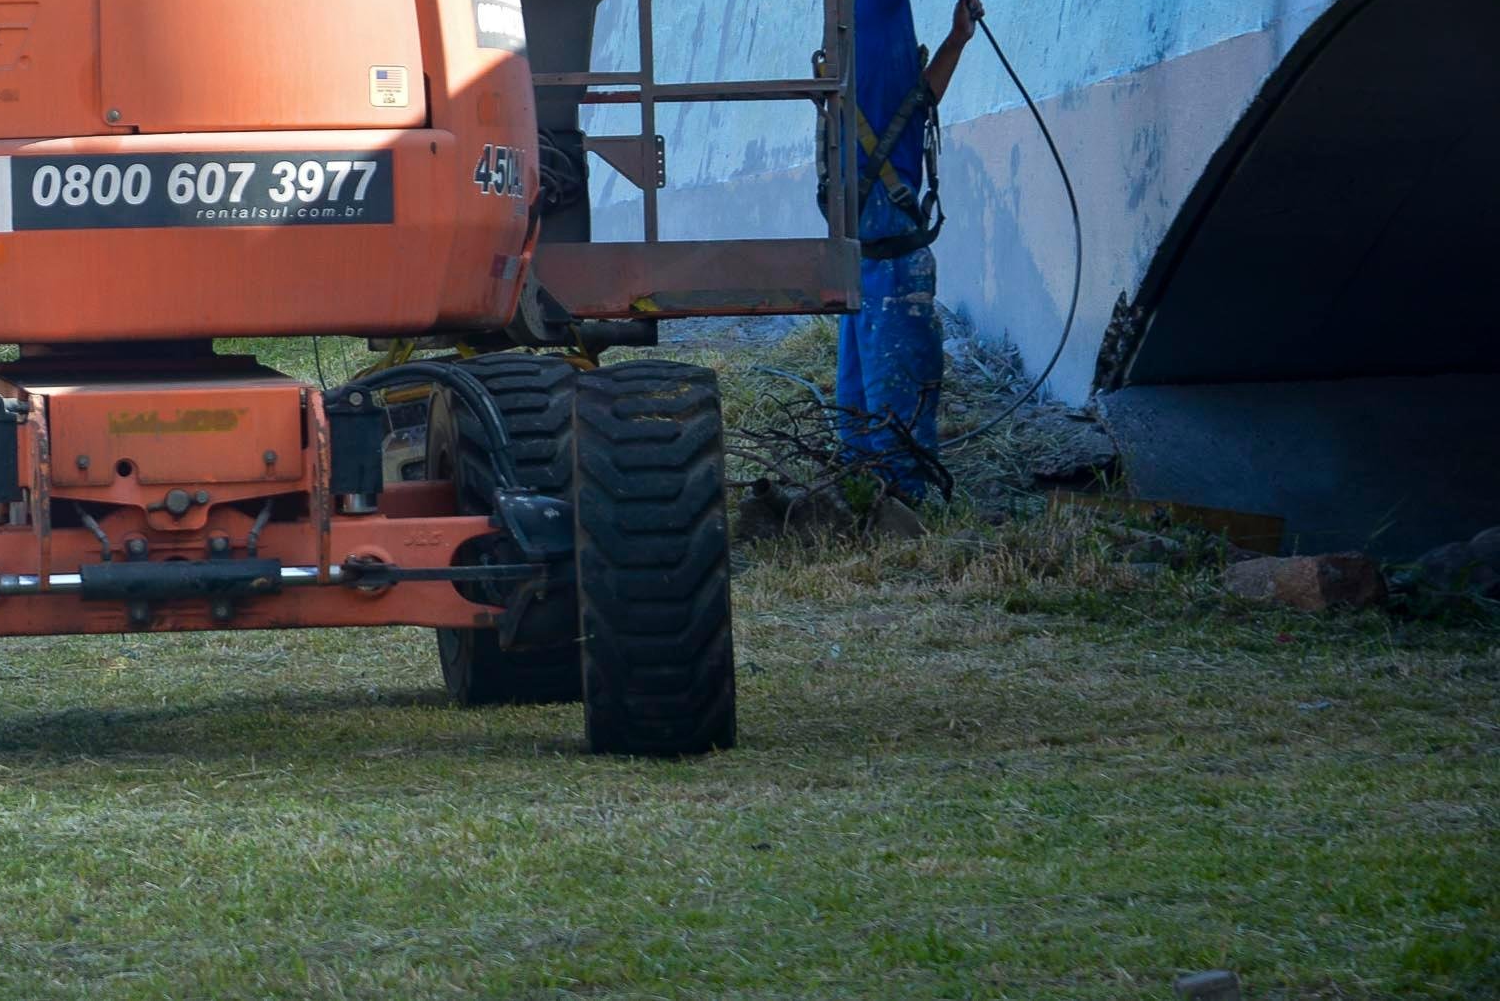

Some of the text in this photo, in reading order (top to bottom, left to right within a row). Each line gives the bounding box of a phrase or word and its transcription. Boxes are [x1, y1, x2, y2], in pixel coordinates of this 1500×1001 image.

[32, 160, 377, 207] 0800 607 3977
[196, 205, 364, 220] rentalsul.com.br
